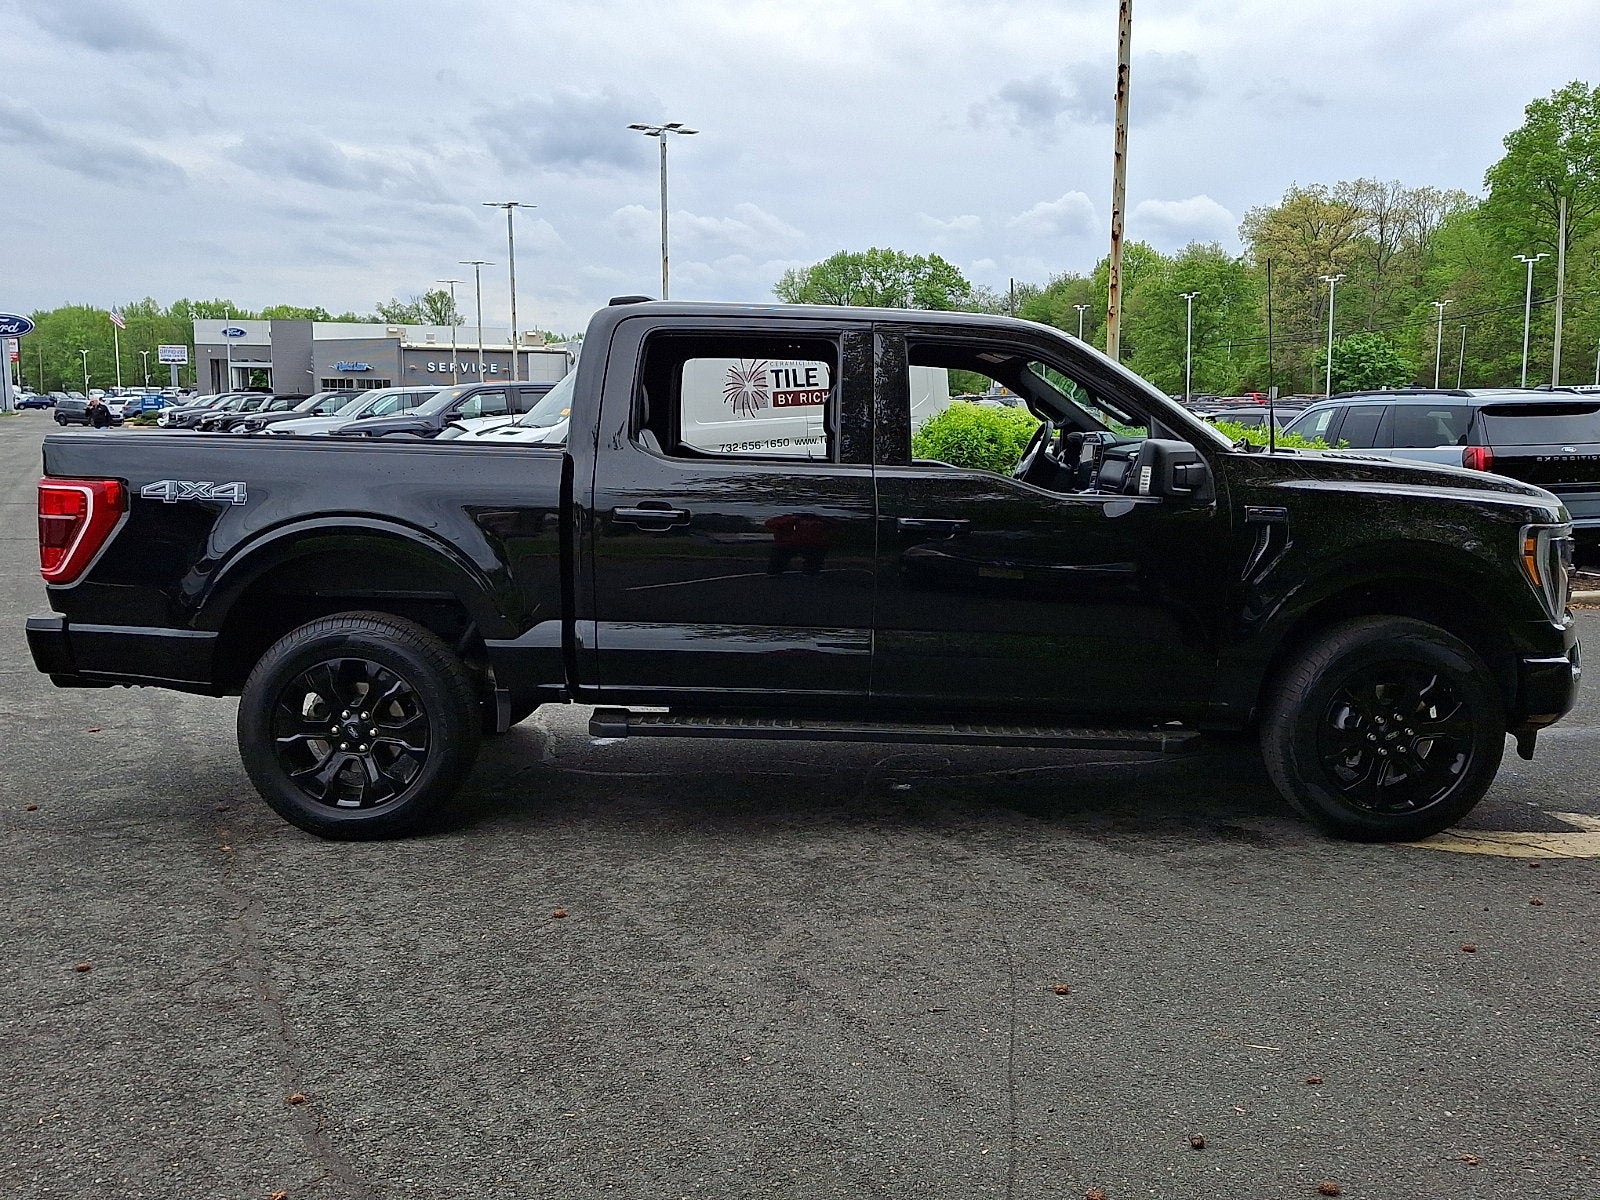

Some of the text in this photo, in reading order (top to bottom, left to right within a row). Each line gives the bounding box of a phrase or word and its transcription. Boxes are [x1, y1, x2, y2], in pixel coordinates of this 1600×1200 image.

[0, 318, 19, 332] rd
[427, 361, 498, 373] SERVICE
[770, 368, 819, 389] TILE
[777, 391, 829, 405] BY RICH
[719, 438, 790, 453] 732-656-1650
